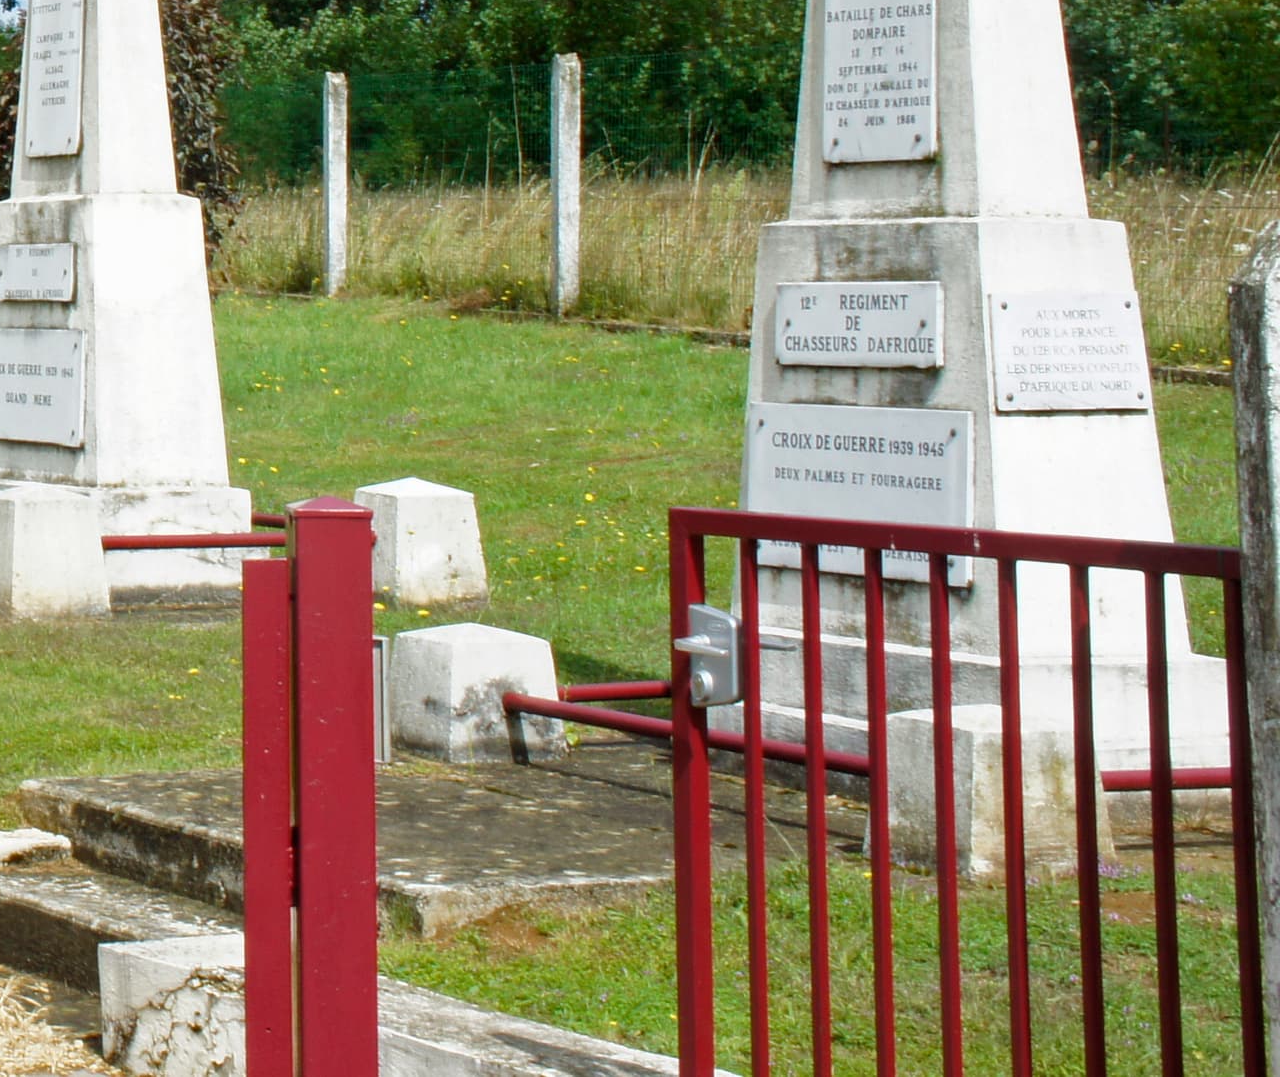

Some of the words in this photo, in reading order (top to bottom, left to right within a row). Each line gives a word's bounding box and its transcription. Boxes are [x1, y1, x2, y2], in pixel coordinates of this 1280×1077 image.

[826, 8, 875, 23] BATAILLE
[880, 6, 893, 19] DE
[896, 4, 932, 18] CHARS
[852, 25, 905, 41] DOMPAIRE
[872, 46, 883, 57] ET
[838, 64, 888, 77] SEPTEMBRE
[847, 83, 858, 93] DE
[840, 294, 909, 310] REGIMENT
[1062, 309, 1101, 320] MORTS
[845, 315, 861, 331] DE
[1021, 327, 1050, 338] POUR
[1054, 327, 1068, 338] LA
[1071, 326, 1116, 338] FRANCE
[785, 336, 857, 352] CHASSEURS
[1078, 345, 1130, 355] PENDANT
[1007, 364, 1027, 374] LES
[1030, 363, 1085, 374] DERNIERS
[1019, 381, 1079, 393] D'AFRIQUE
[1081, 381, 1096, 392] DU
[1100, 380, 1132, 392] NORD
[772, 432, 812, 450] CROIX
[816, 436, 831, 451] DE
[834, 436, 886, 453] GUERRE
[889, 440, 914, 455] 1939
[918, 442, 945, 457] 1945
[775, 467, 800, 480] DEUX
[804, 469, 845, 484] PALMES
[852, 473, 865, 486] ET
[871, 474, 942, 491] FOURRAGERE
